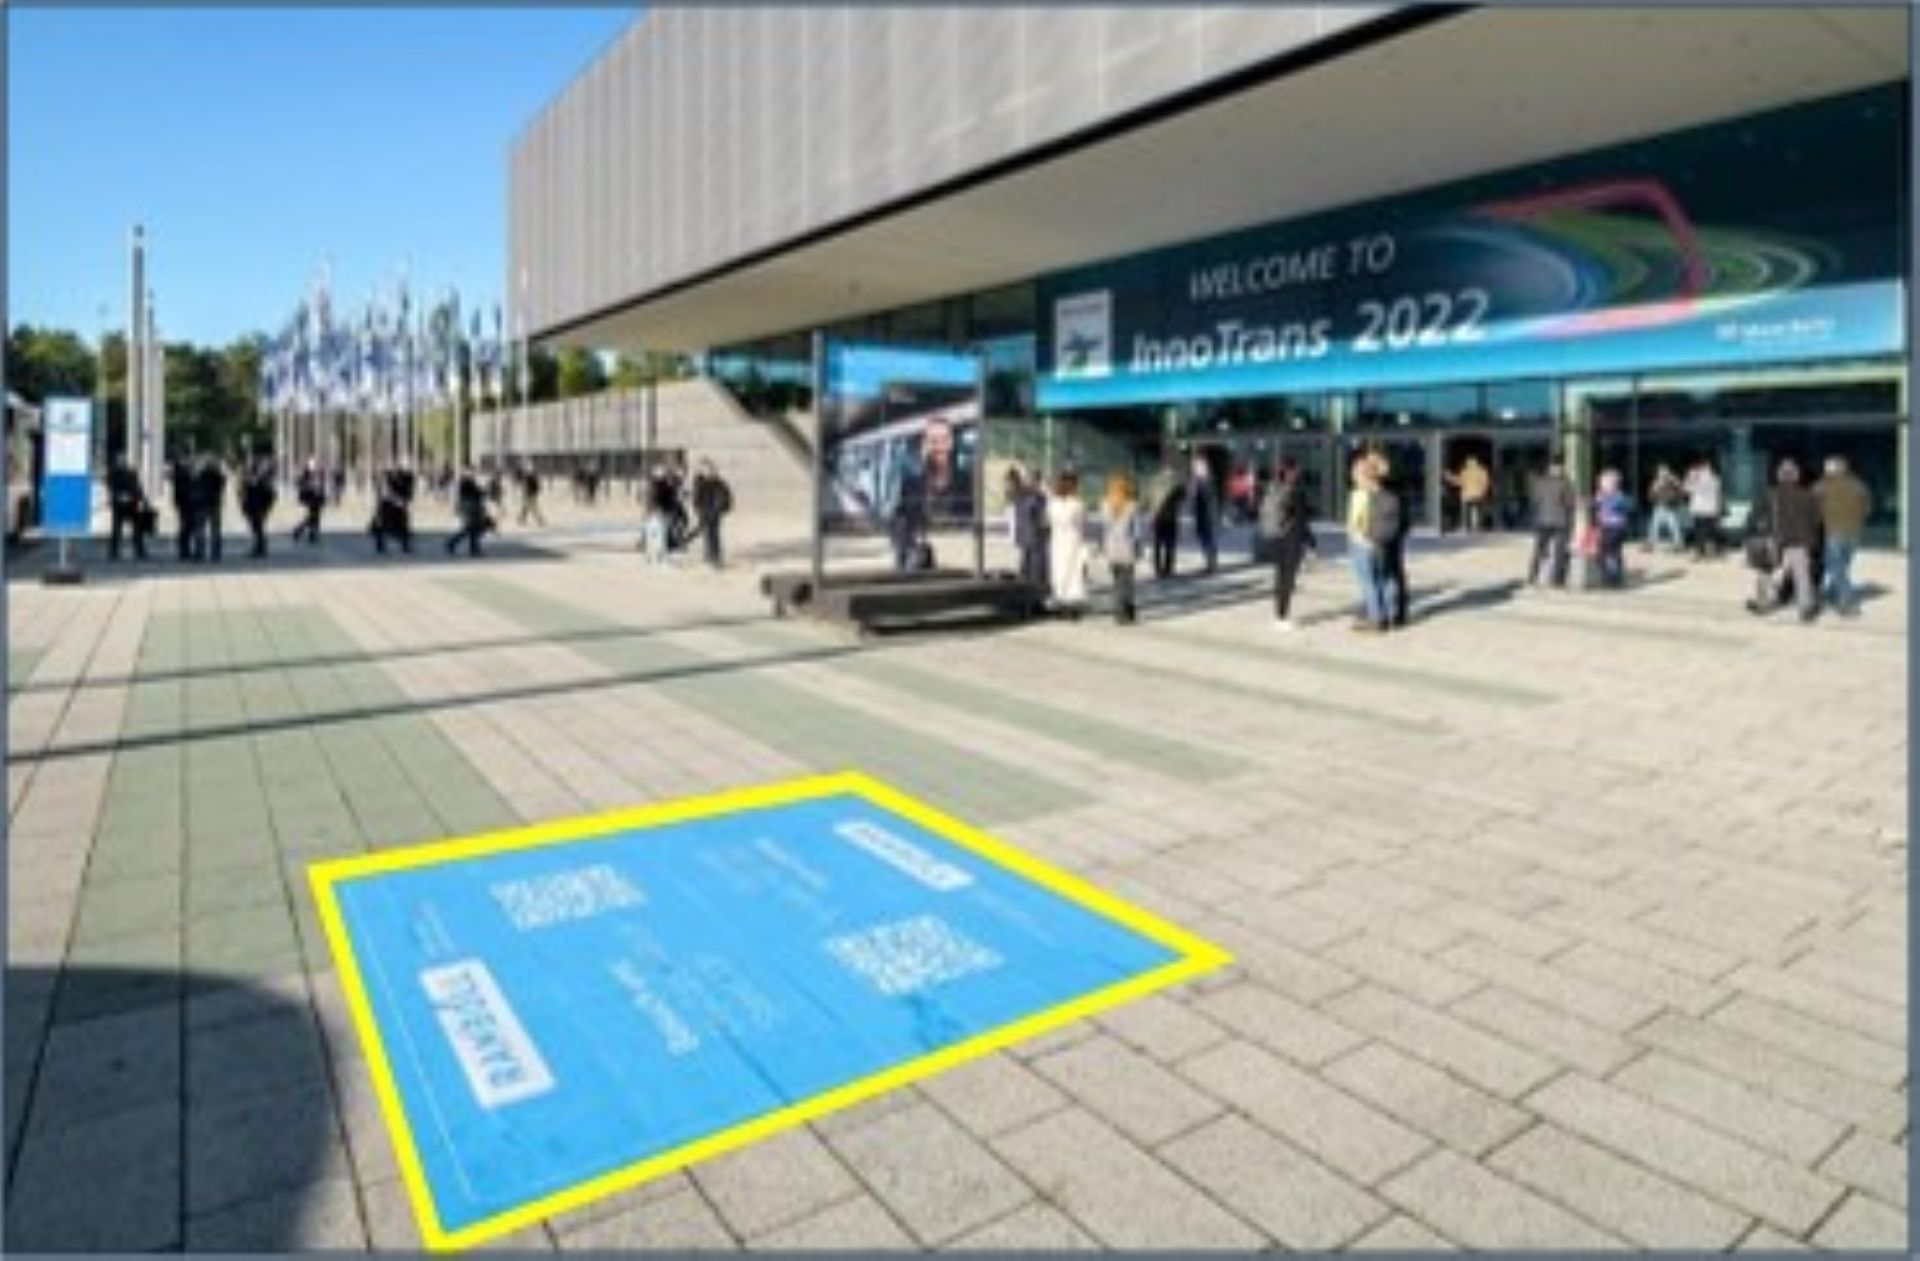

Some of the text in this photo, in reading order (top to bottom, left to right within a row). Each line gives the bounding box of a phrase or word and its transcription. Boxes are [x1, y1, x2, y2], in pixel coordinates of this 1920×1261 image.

[1189, 231, 1396, 301] WELCOME TO
[1129, 287, 1490, 374] InnoTrans 2022
